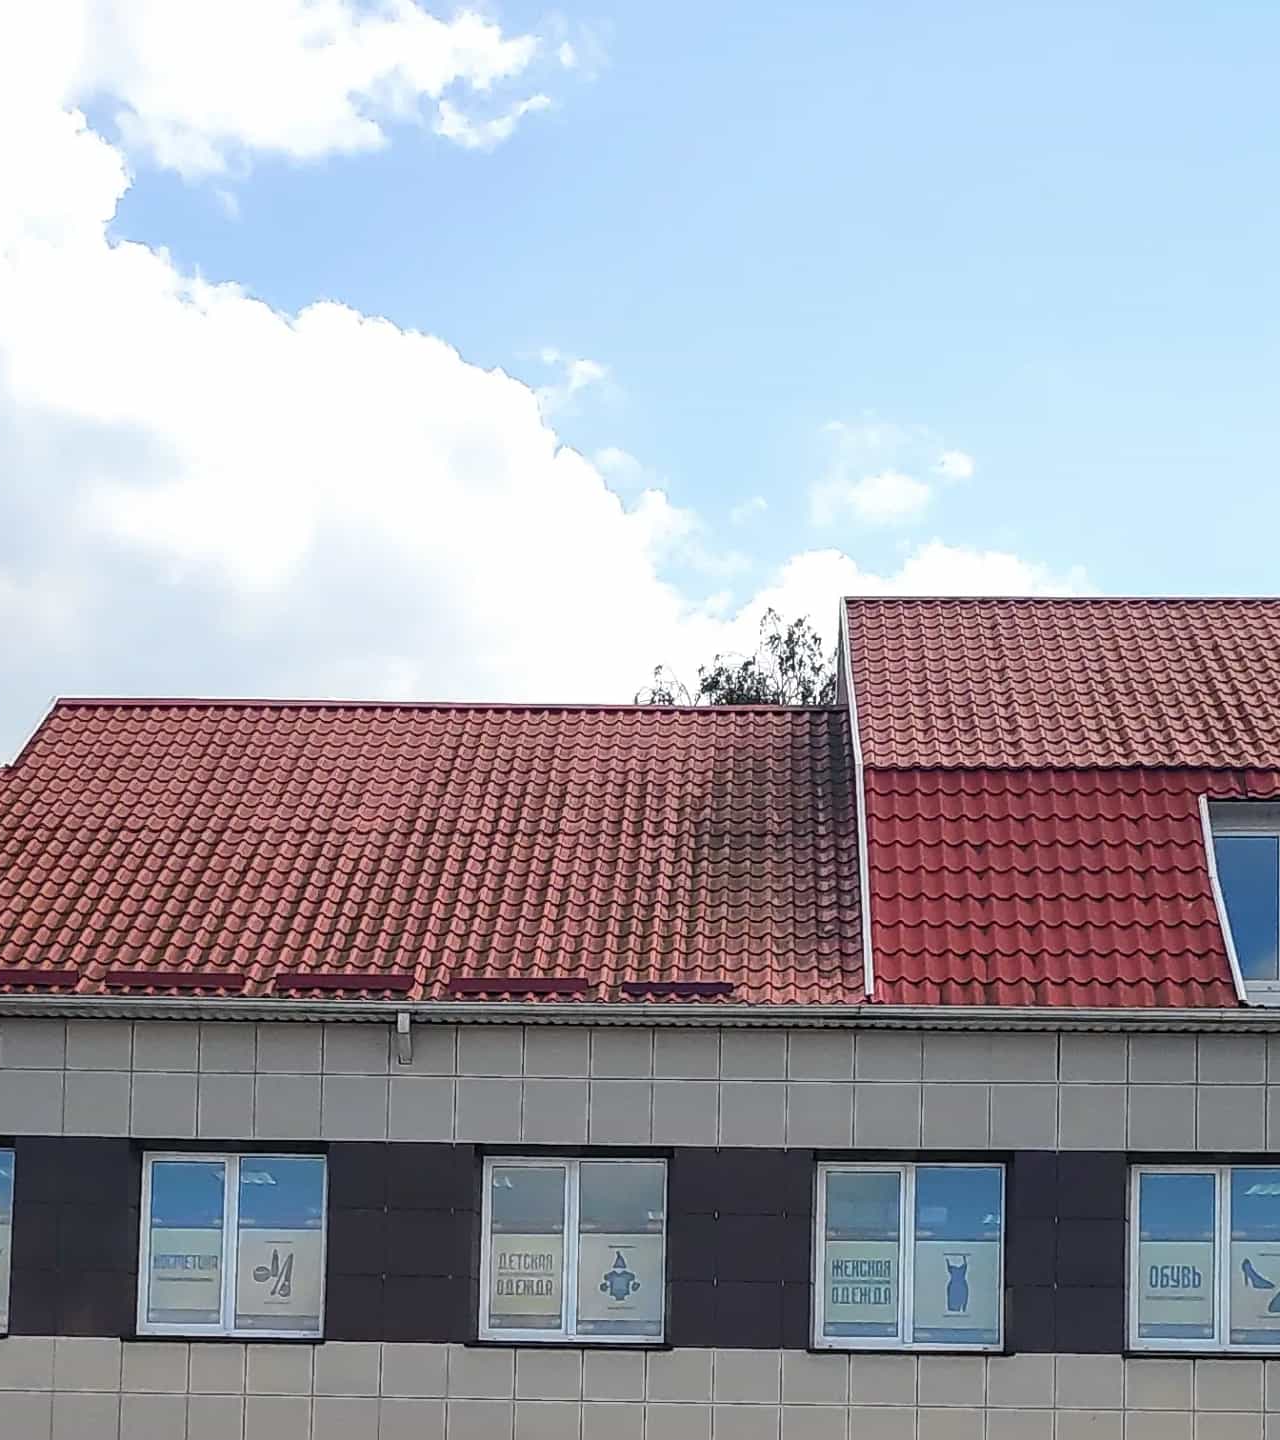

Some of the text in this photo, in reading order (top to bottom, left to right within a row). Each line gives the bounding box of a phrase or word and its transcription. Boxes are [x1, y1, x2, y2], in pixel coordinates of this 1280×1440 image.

[497, 1252, 554, 1271] ДЕТСКАЯ
[831, 1259, 892, 1278] ЖЕНСКАЯ
[1149, 1264, 1202, 1289] ОБУВЬ
[496, 1278, 554, 1297] ОДЕЖДА
[831, 1286, 892, 1305] ОДЕЖДА
